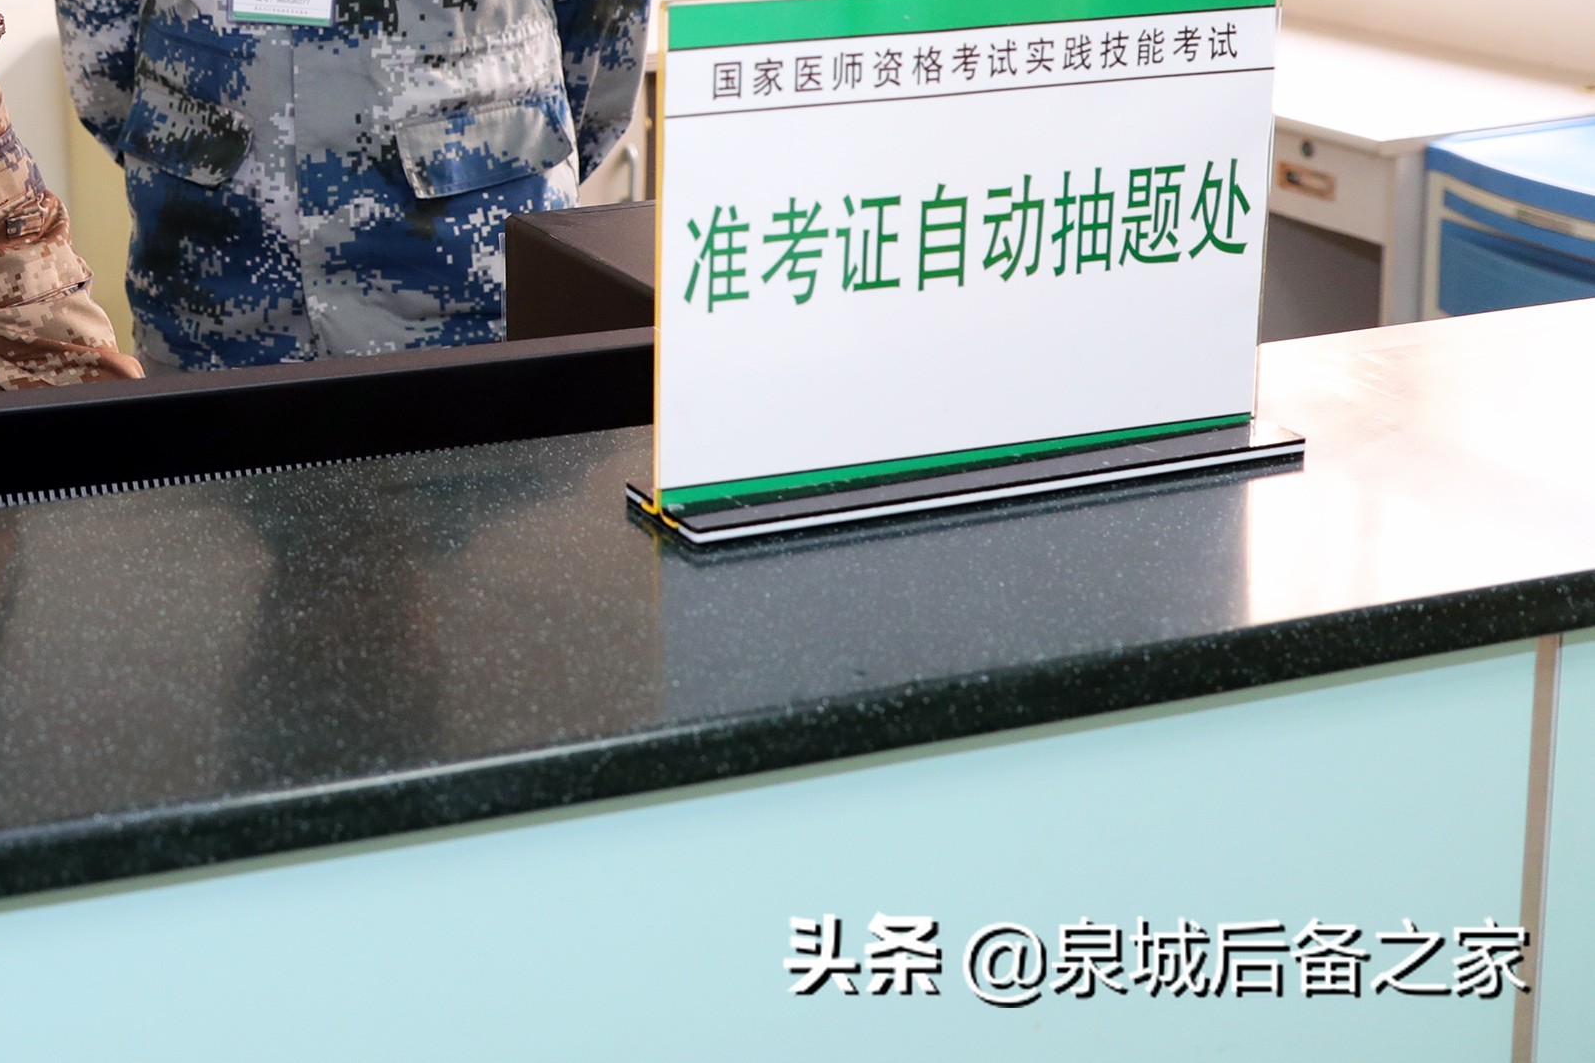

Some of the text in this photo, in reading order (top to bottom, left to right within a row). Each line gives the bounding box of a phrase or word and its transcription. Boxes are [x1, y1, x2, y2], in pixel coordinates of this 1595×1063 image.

[711, 23, 1240, 101] 国家医师资格考试实践技能考试
[683, 158, 1252, 314] 准考证自动抽题处
